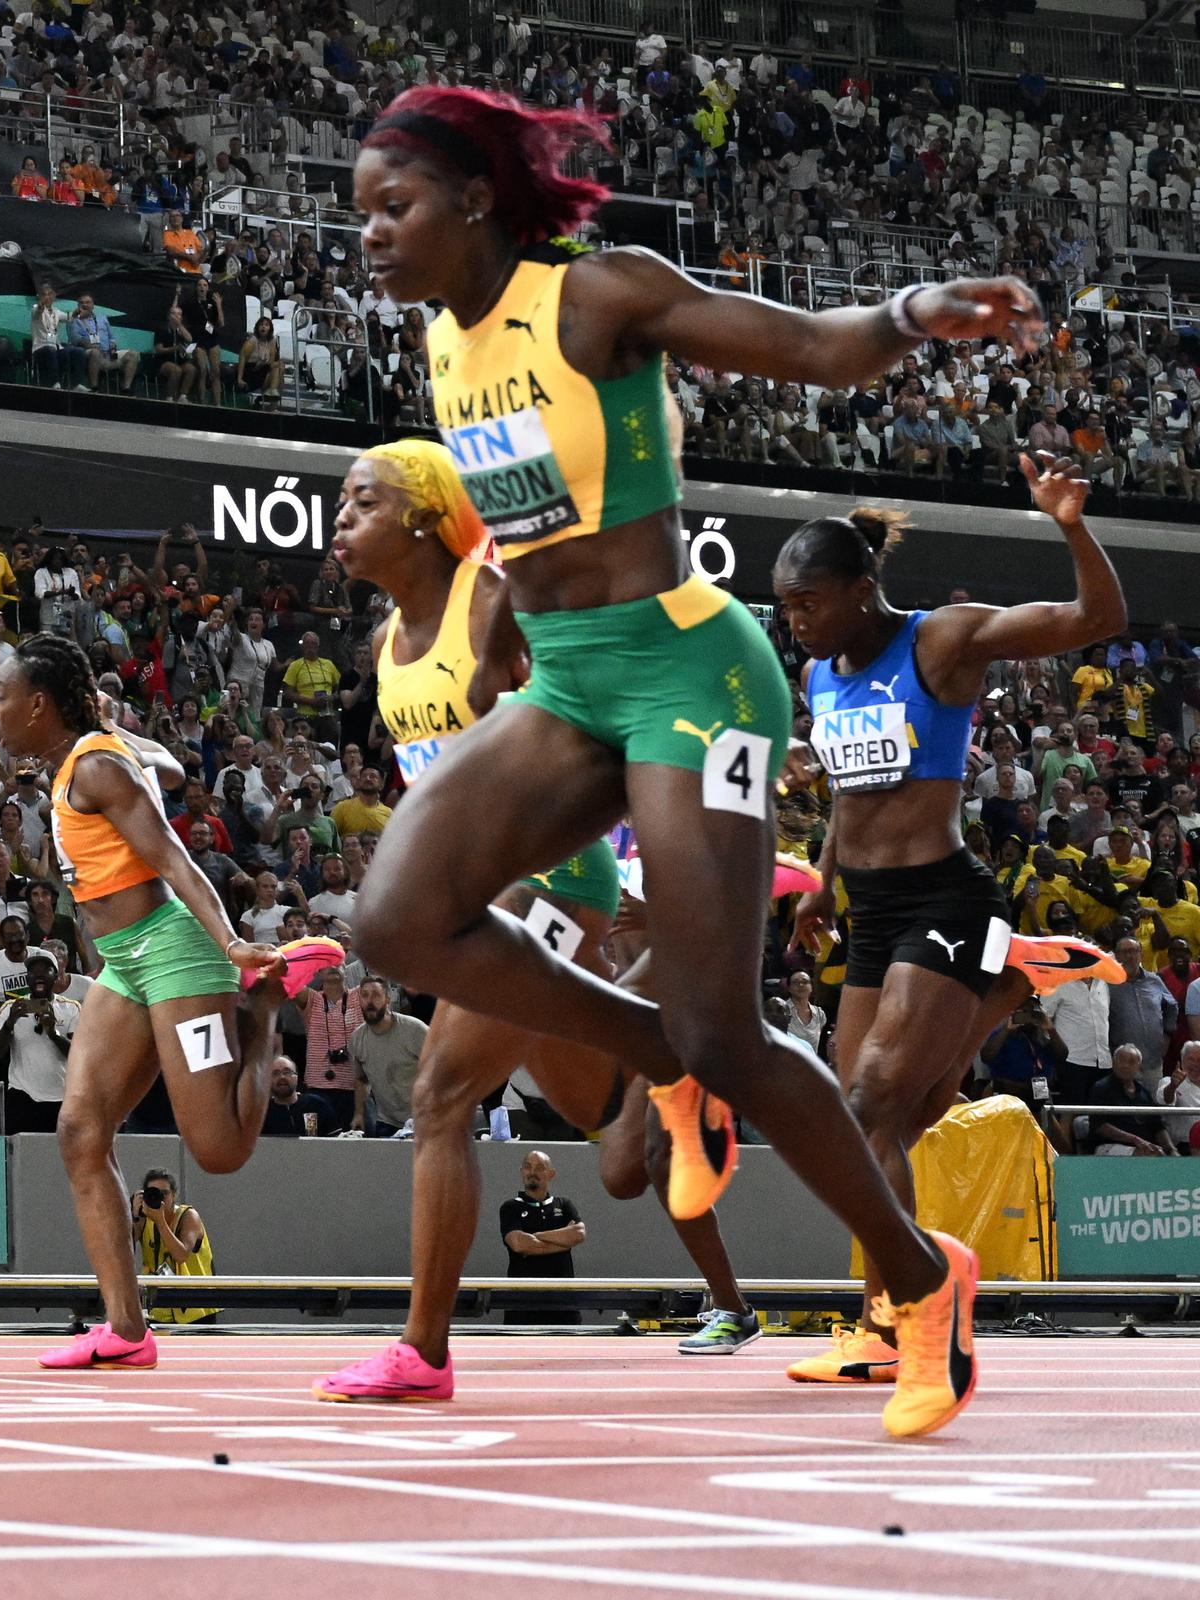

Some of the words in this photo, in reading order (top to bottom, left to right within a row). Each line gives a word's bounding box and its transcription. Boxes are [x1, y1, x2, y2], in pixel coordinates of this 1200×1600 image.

[213, 475, 323, 550] NŐI
[824, 706, 884, 740] NTN
[725, 745, 753, 800] 4
[838, 773, 889, 788] BUDAPEST
[543, 918, 566, 951] 5
[192, 1023, 211, 1060] 7
[1069, 1223, 1098, 1237] THE
